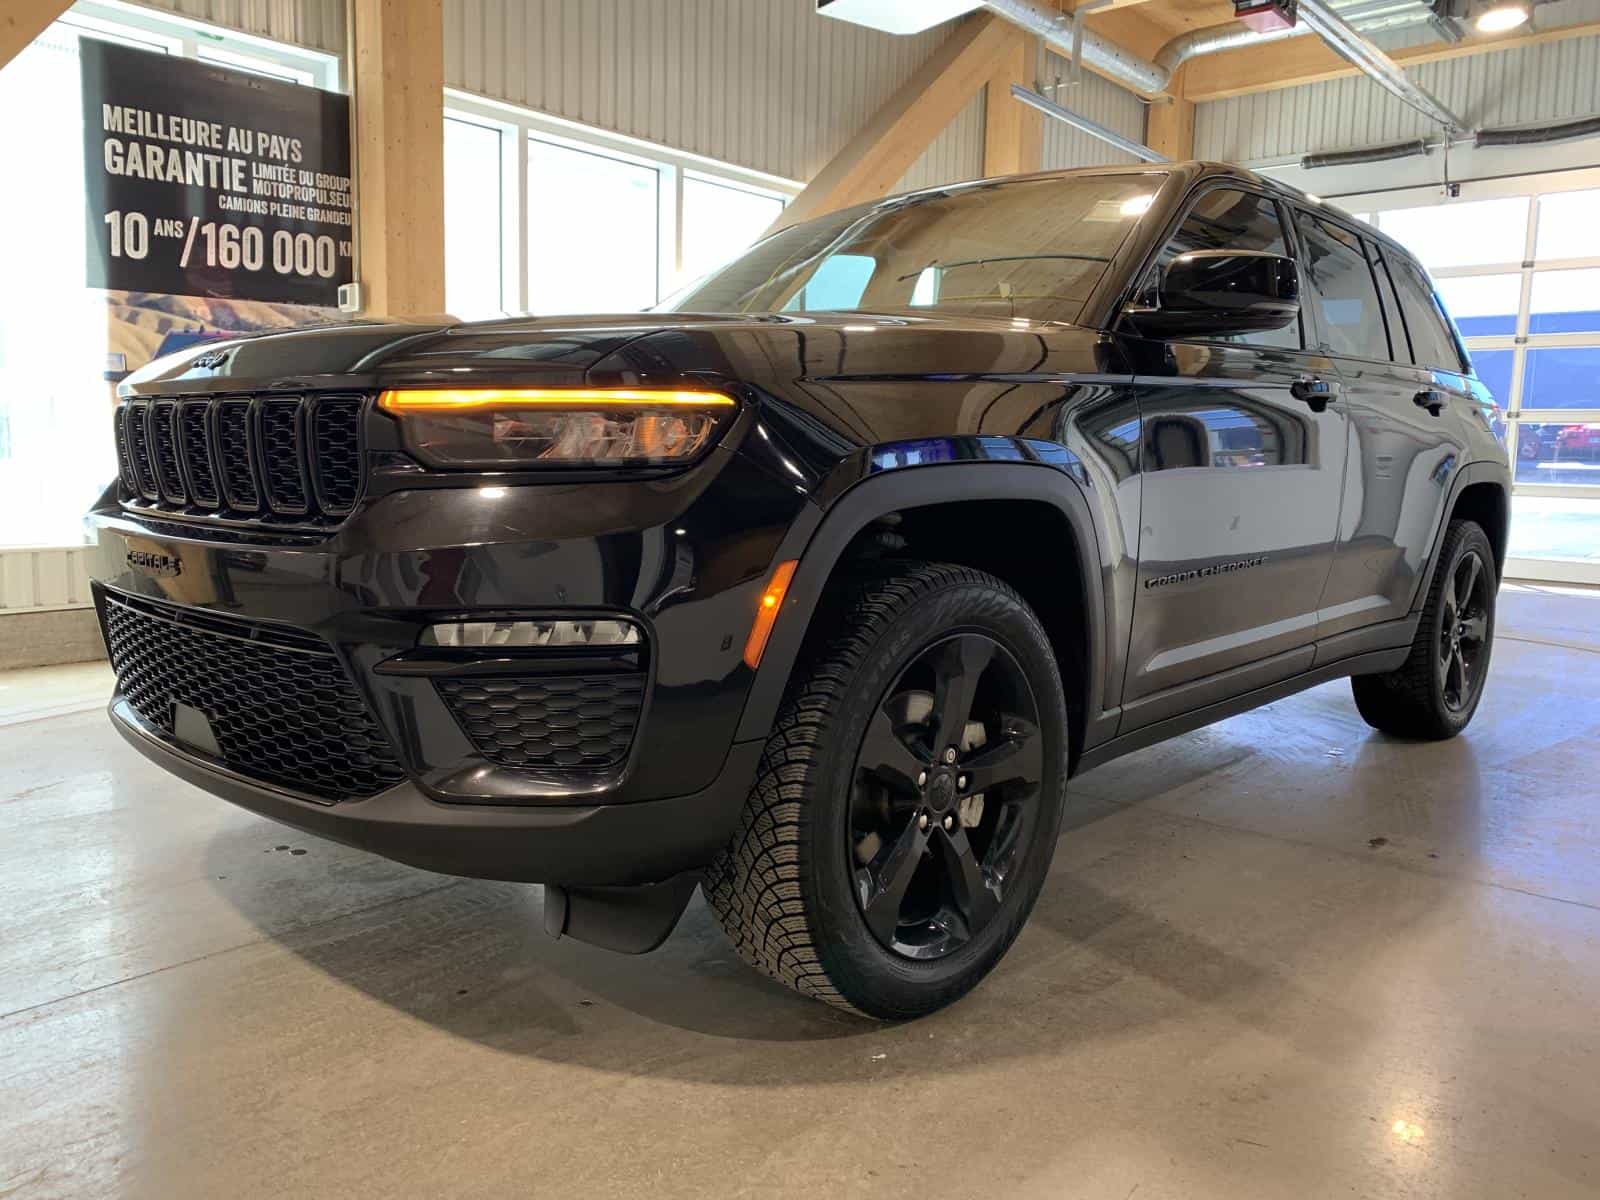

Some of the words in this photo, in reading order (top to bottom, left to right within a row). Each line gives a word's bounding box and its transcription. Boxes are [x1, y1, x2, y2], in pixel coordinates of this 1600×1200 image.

[102, 103, 222, 149] MEILLEURE
[227, 127, 252, 154] AU
[257, 132, 302, 162] PAYS
[104, 138, 247, 192] GARANTIE
[252, 161, 297, 184] LIMITÉE
[299, 170, 314, 186] DU
[316, 173, 351, 192] GROUP
[252, 178, 351, 208] MOTOPROPULSEU
[218, 195, 268, 215] CAMIONS
[269, 202, 306, 220] PLEINE
[307, 207, 352, 226] GRANDEU
[104, 210, 149, 260] 10
[154, 218, 184, 238] ANS
[1198, 557, 1269, 577] CHEROKEE
